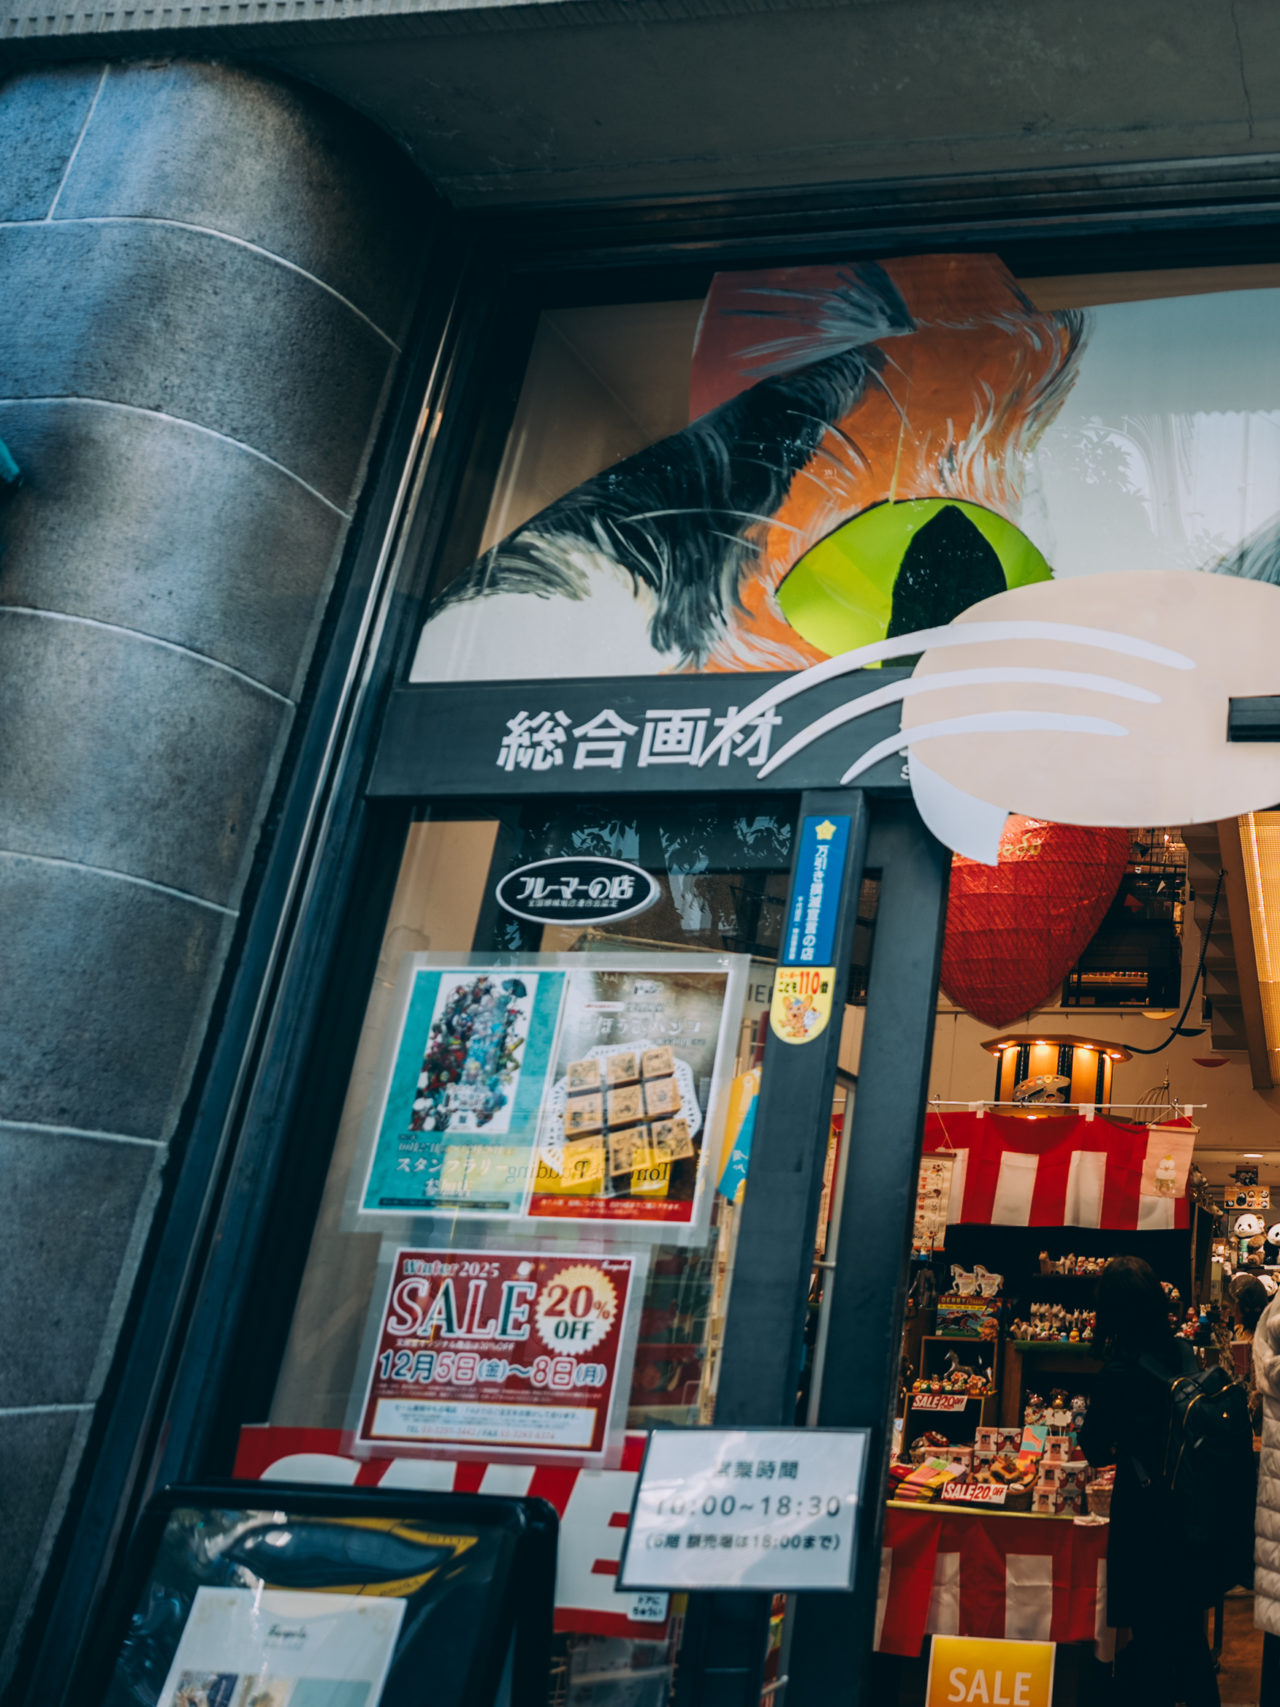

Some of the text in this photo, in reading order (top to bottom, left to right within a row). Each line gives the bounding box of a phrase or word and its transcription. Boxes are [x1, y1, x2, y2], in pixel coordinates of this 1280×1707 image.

[387, 1277, 538, 1341] SALE
[544, 1284, 610, 1320] 20%
[554, 1320, 595, 1340] OFF
[914, 1394, 940, 1408] SALE
[944, 1483, 976, 1499] SALE
[947, 1667, 1032, 1706] SALE
